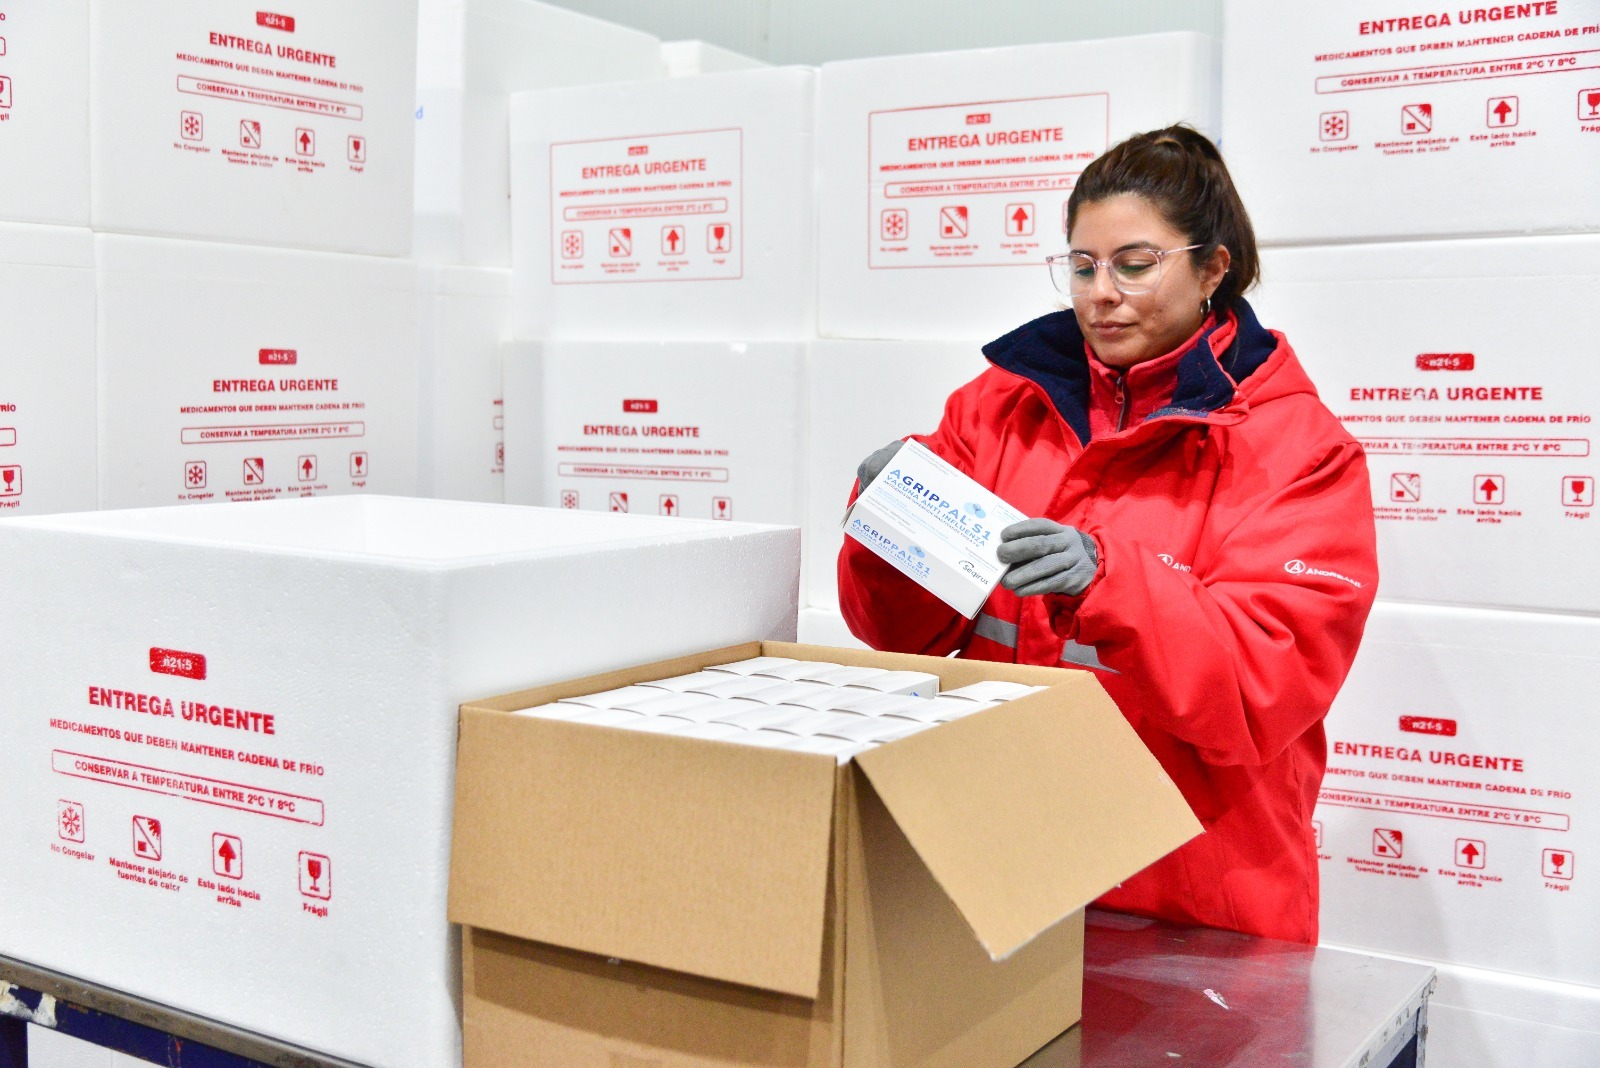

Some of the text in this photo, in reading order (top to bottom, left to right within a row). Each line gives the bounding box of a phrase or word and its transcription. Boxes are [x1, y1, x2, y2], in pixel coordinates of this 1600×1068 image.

[1359, 0, 1557, 35] ENTREGA URGENTE
[209, 31, 336, 68] ENTREGA URGENTE
[908, 127, 1063, 151] ENTREGA URGENTE
[582, 158, 706, 179] ENTREGA URGENTE
[212, 379, 337, 393] ENTREGA URGENTE
[1447, 386, 1542, 401] URGENTE
[583, 425, 699, 438] ENTREGA URGENTE
[886, 475, 919, 500] VACUNA
[920, 500, 941, 515] ANTI
[942, 514, 985, 546] INFLUENZA
[890, 469, 968, 525] AGRIPPAL
[972, 523, 992, 541] S1
[853, 519, 930, 574] AGRIPPAL S1
[962, 564, 988, 584] Seqirus
[88, 686, 274, 735] ENTREGA URGENTE
[50, 719, 324, 776] MEDICAMENTOS QUE DEBEN MANTENER CADENA DE FRÍO
[1333, 741, 1523, 772] ENTREGA URGENTE
[75, 760, 130, 779] CONSERVAR
[131, 772, 138, 781] A
[141, 773, 210, 795] TEMPERATURA
[212, 786, 245, 803] ENTRE
[268, 798, 275, 807] Y
